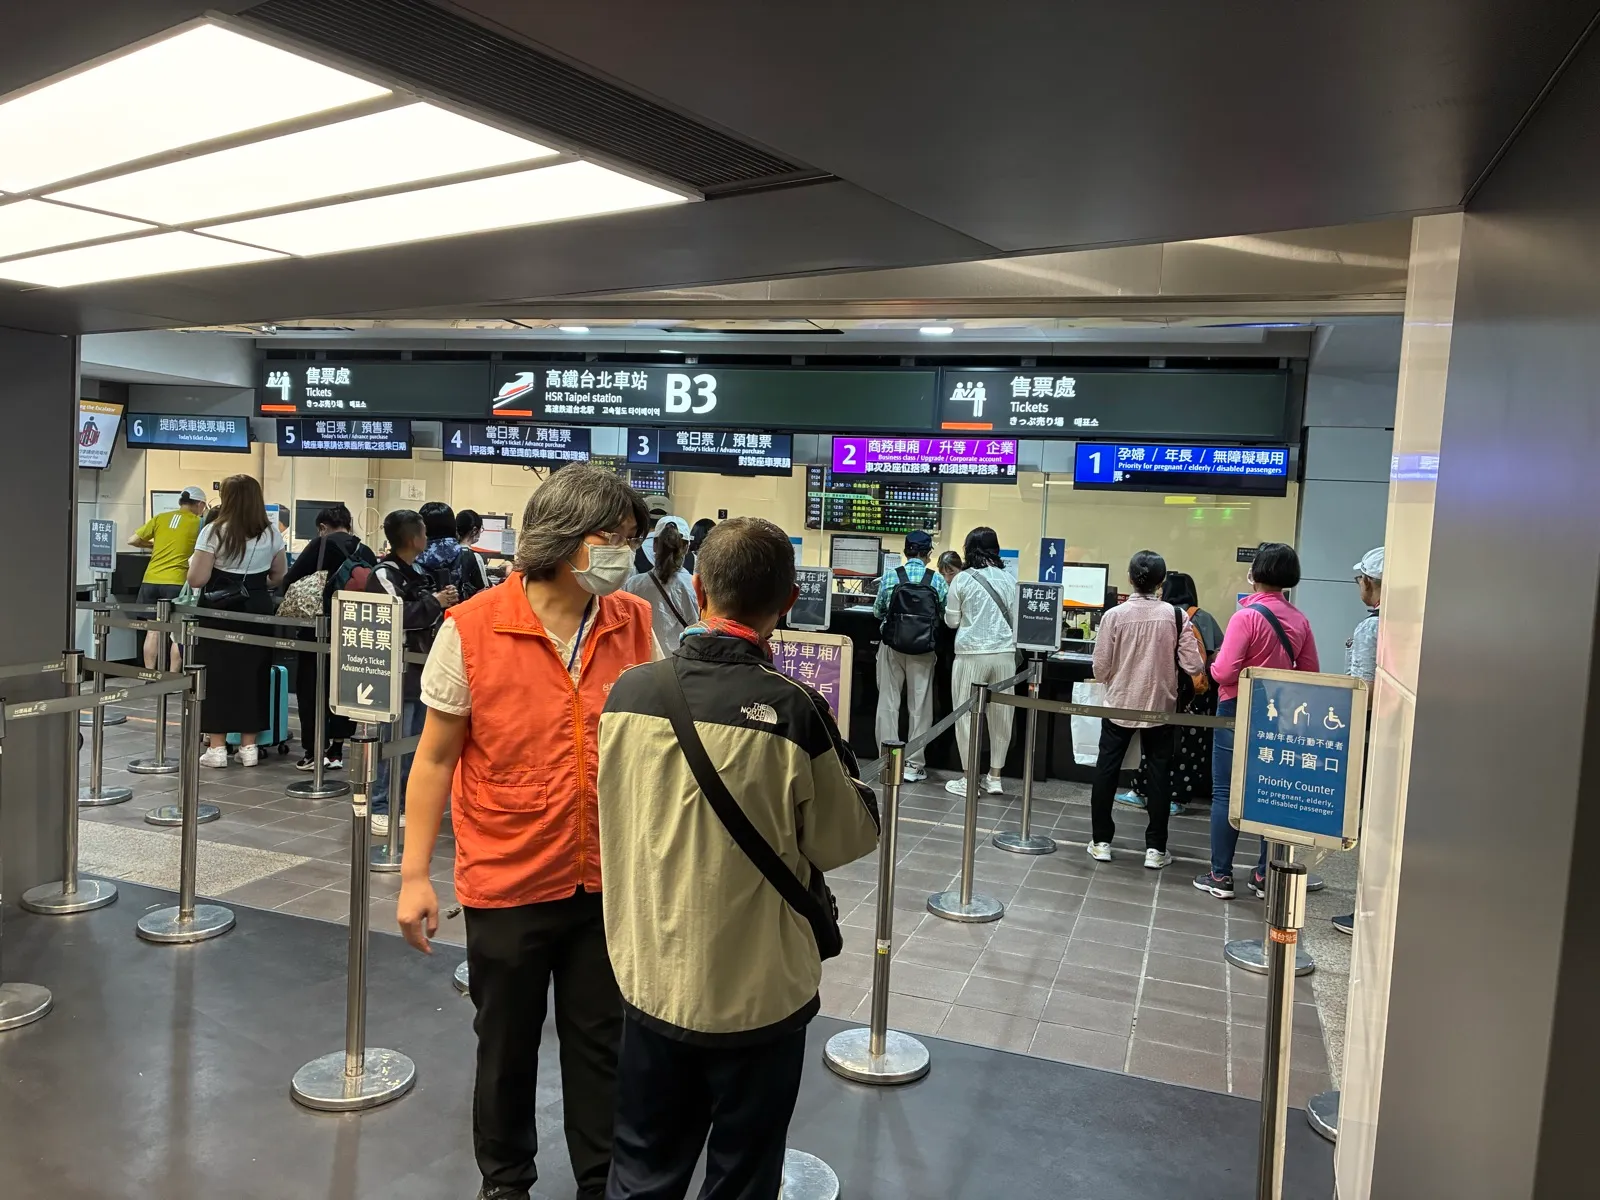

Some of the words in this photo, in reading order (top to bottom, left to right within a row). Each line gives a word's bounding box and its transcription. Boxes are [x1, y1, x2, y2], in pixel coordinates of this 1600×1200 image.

[305, 367, 351, 385] 售票處
[545, 369, 648, 390] 高鐵台北車站
[305, 387, 332, 397] Tickets
[665, 373, 717, 414] B3
[1010, 376, 1076, 398] 售票處
[545, 392, 563, 401] HSR
[564, 392, 590, 404] Taipei
[592, 393, 622, 403] station
[1010, 401, 1049, 413] Tickets
[133, 420, 144, 437] 6
[160, 418, 235, 433] 提前乘車換票專用
[316, 421, 347, 433] 當日票
[361, 421, 393, 434] 預售票
[486, 425, 520, 440] 當日票
[536, 428, 571, 442] 預售票
[285, 425, 296, 444] 5
[451, 430, 462, 448] 4
[676, 431, 714, 446] 當日票
[733, 433, 772, 448] 預售票
[637, 435, 649, 455] 3
[868, 440, 920, 453] 商務車廂
[940, 440, 966, 454] 升等
[986, 441, 1014, 455] 企業
[842, 445, 856, 465] 2
[1089, 452, 1101, 474] 1
[1118, 448, 1145, 461] 孕婦
[1165, 449, 1193, 463] 年長
[1213, 450, 1284, 465] 無障礙專用
[1118, 462, 1142, 470] Priority
[1154, 464, 1182, 472] pregnant
[1188, 464, 1211, 472] elderly
[796, 572, 826, 582] 請在此
[800, 582, 820, 594] 等候
[1022, 587, 1056, 600] 請在此
[343, 601, 392, 624] 當日票
[1027, 601, 1050, 613] 等候
[342, 626, 392, 650] 預售票
[347, 654, 368, 664] Today's
[369, 656, 385, 666] Ticket
[341, 664, 364, 674] Advance
[365, 666, 391, 676] Purchase
[740, 706, 765, 715] NORTH
[753, 702, 767, 710] THE
[746, 712, 764, 720] FACE
[1257, 730, 1343, 751] 孕婦/年長/行動不便者
[1258, 747, 1339, 773] 專用窗口
[1258, 775, 1293, 791] Priority
[1294, 780, 1335, 796] Counter
[1257, 797, 1269, 805] and
[1270, 799, 1298, 810] disabled
[1299, 804, 1333, 816] passenger
[1270, 790, 1304, 803] pregnant,
[1307, 796, 1334, 808] elderly,
